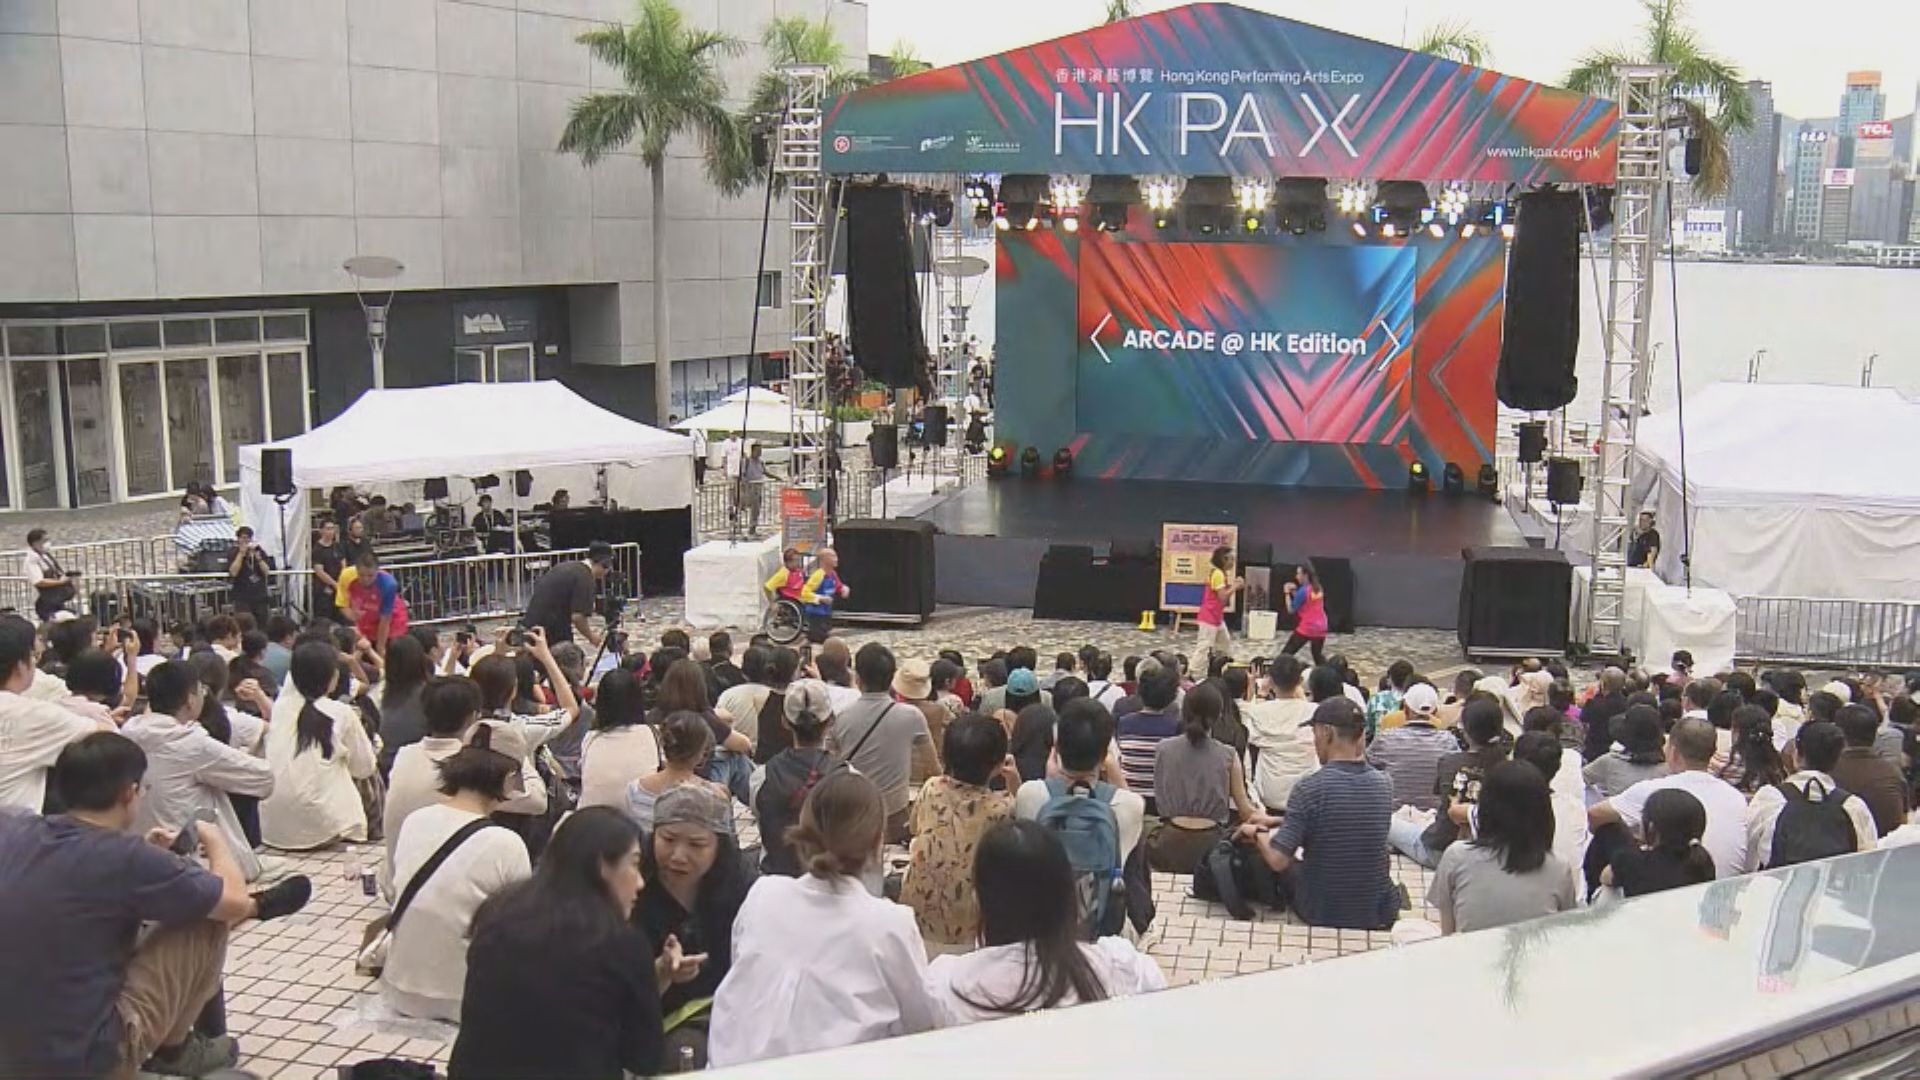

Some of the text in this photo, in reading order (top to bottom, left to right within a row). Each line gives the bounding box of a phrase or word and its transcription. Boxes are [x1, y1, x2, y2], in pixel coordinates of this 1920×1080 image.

[1160, 69, 1365, 86] Hong Kong Performing Arts Expo
[1054, 91, 1152, 156] HK
[1860, 123, 1893, 136] TCL
[1486, 145, 1601, 161] www.hkpax.org.hk
[1122, 328, 1367, 356] ARCADE @ HK Edition
